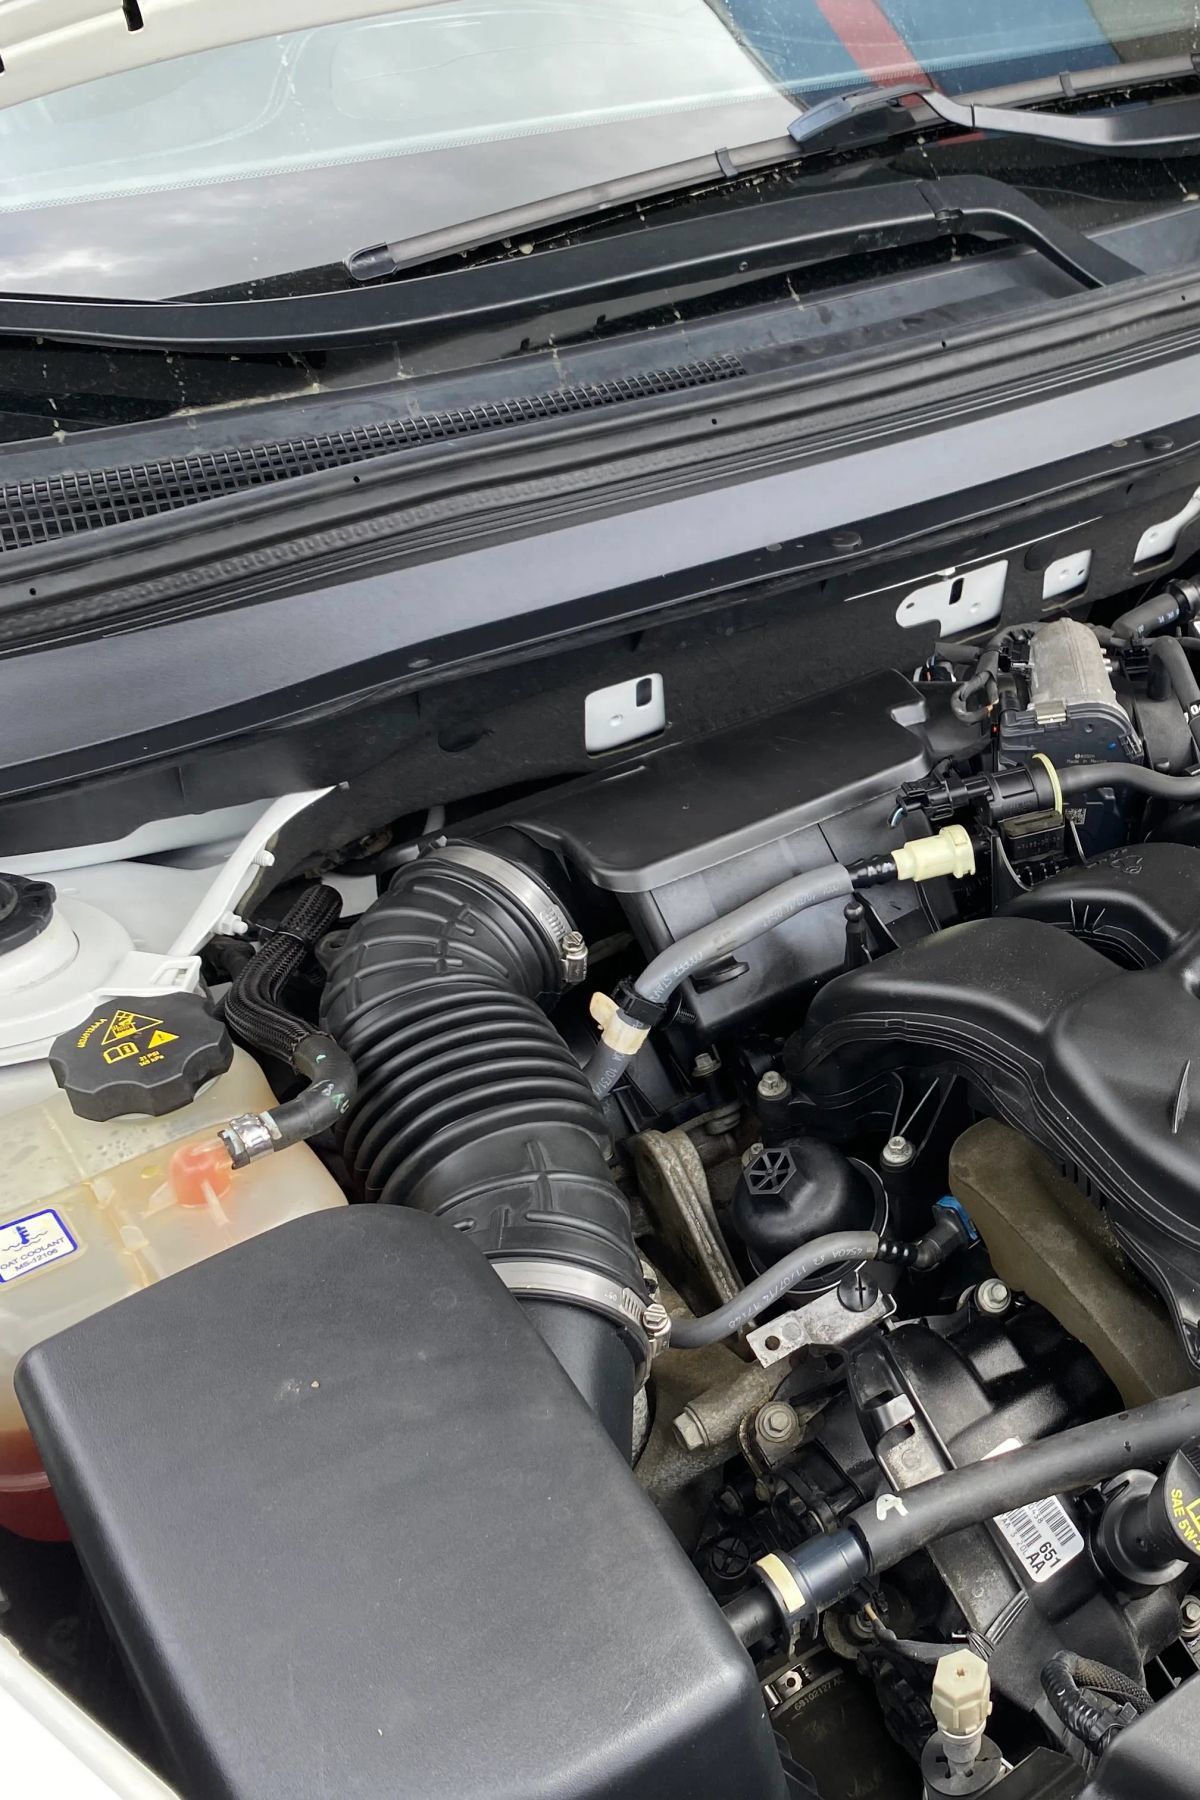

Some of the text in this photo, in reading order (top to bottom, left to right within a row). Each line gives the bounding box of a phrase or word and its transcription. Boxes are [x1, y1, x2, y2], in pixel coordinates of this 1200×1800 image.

[20, 1237, 64, 1260] COOLANT
[1170, 1488, 1186, 1518] SAE
[1025, 1551, 1046, 1574] AA
[1039, 1541, 1063, 1568] 651
